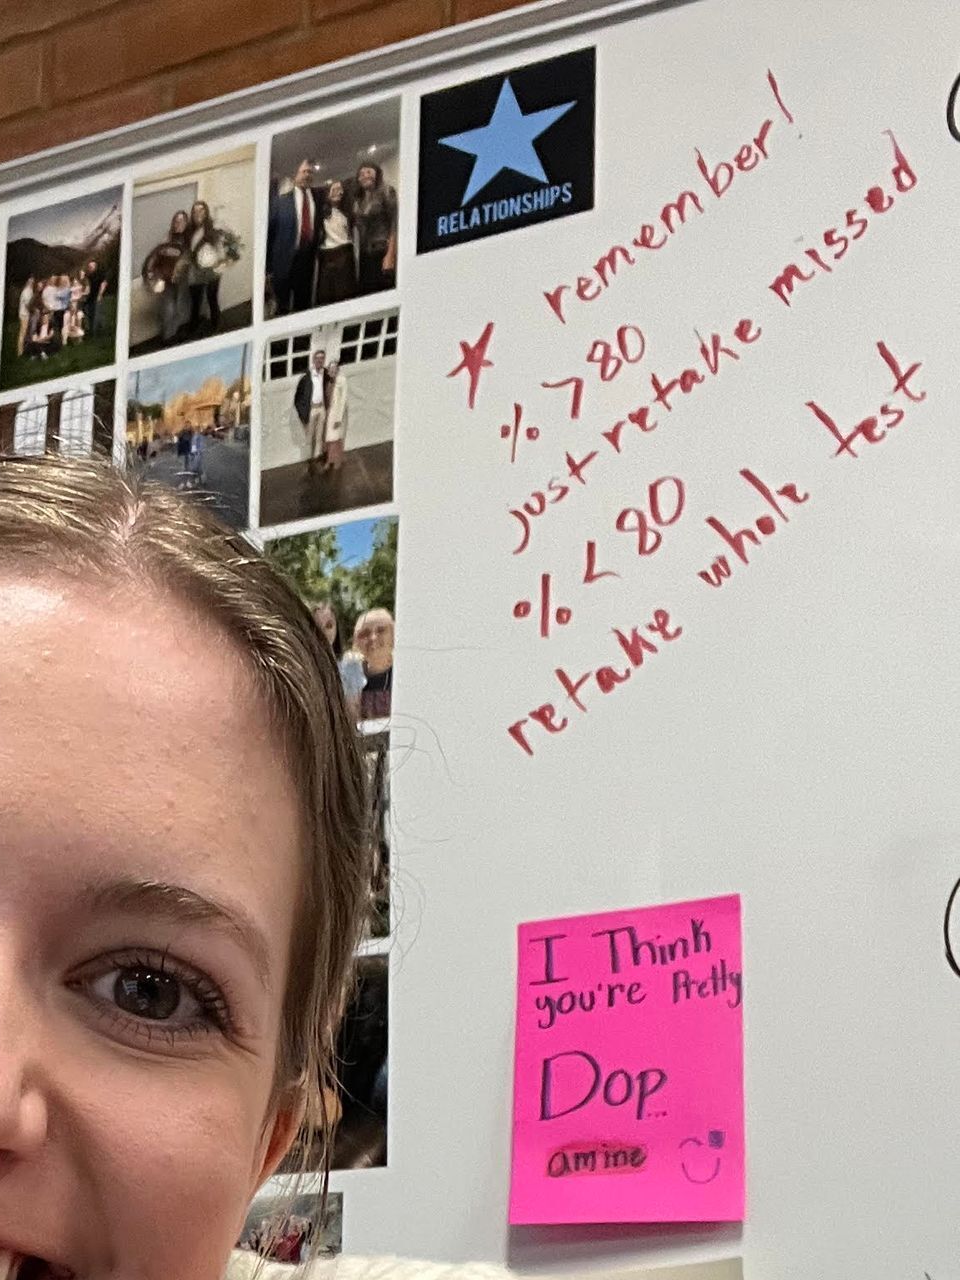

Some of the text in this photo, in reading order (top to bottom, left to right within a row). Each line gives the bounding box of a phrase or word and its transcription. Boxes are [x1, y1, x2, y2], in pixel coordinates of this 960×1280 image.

[437, 182, 573, 237] RELATIONSHIPS
[543, 68, 802, 324] remember!
[501, 403, 539, 463] %
[587, 325, 645, 381] 80
[509, 451, 598, 555] just
[769, 129, 918, 306] missed
[507, 340, 926, 756] retake whole test
[513, 573, 572, 638] %
[615, 476, 685, 555] 80
[529, 918, 712, 986] I Think
[536, 981, 647, 1029] you're
[548, 1142, 647, 1178] amine
